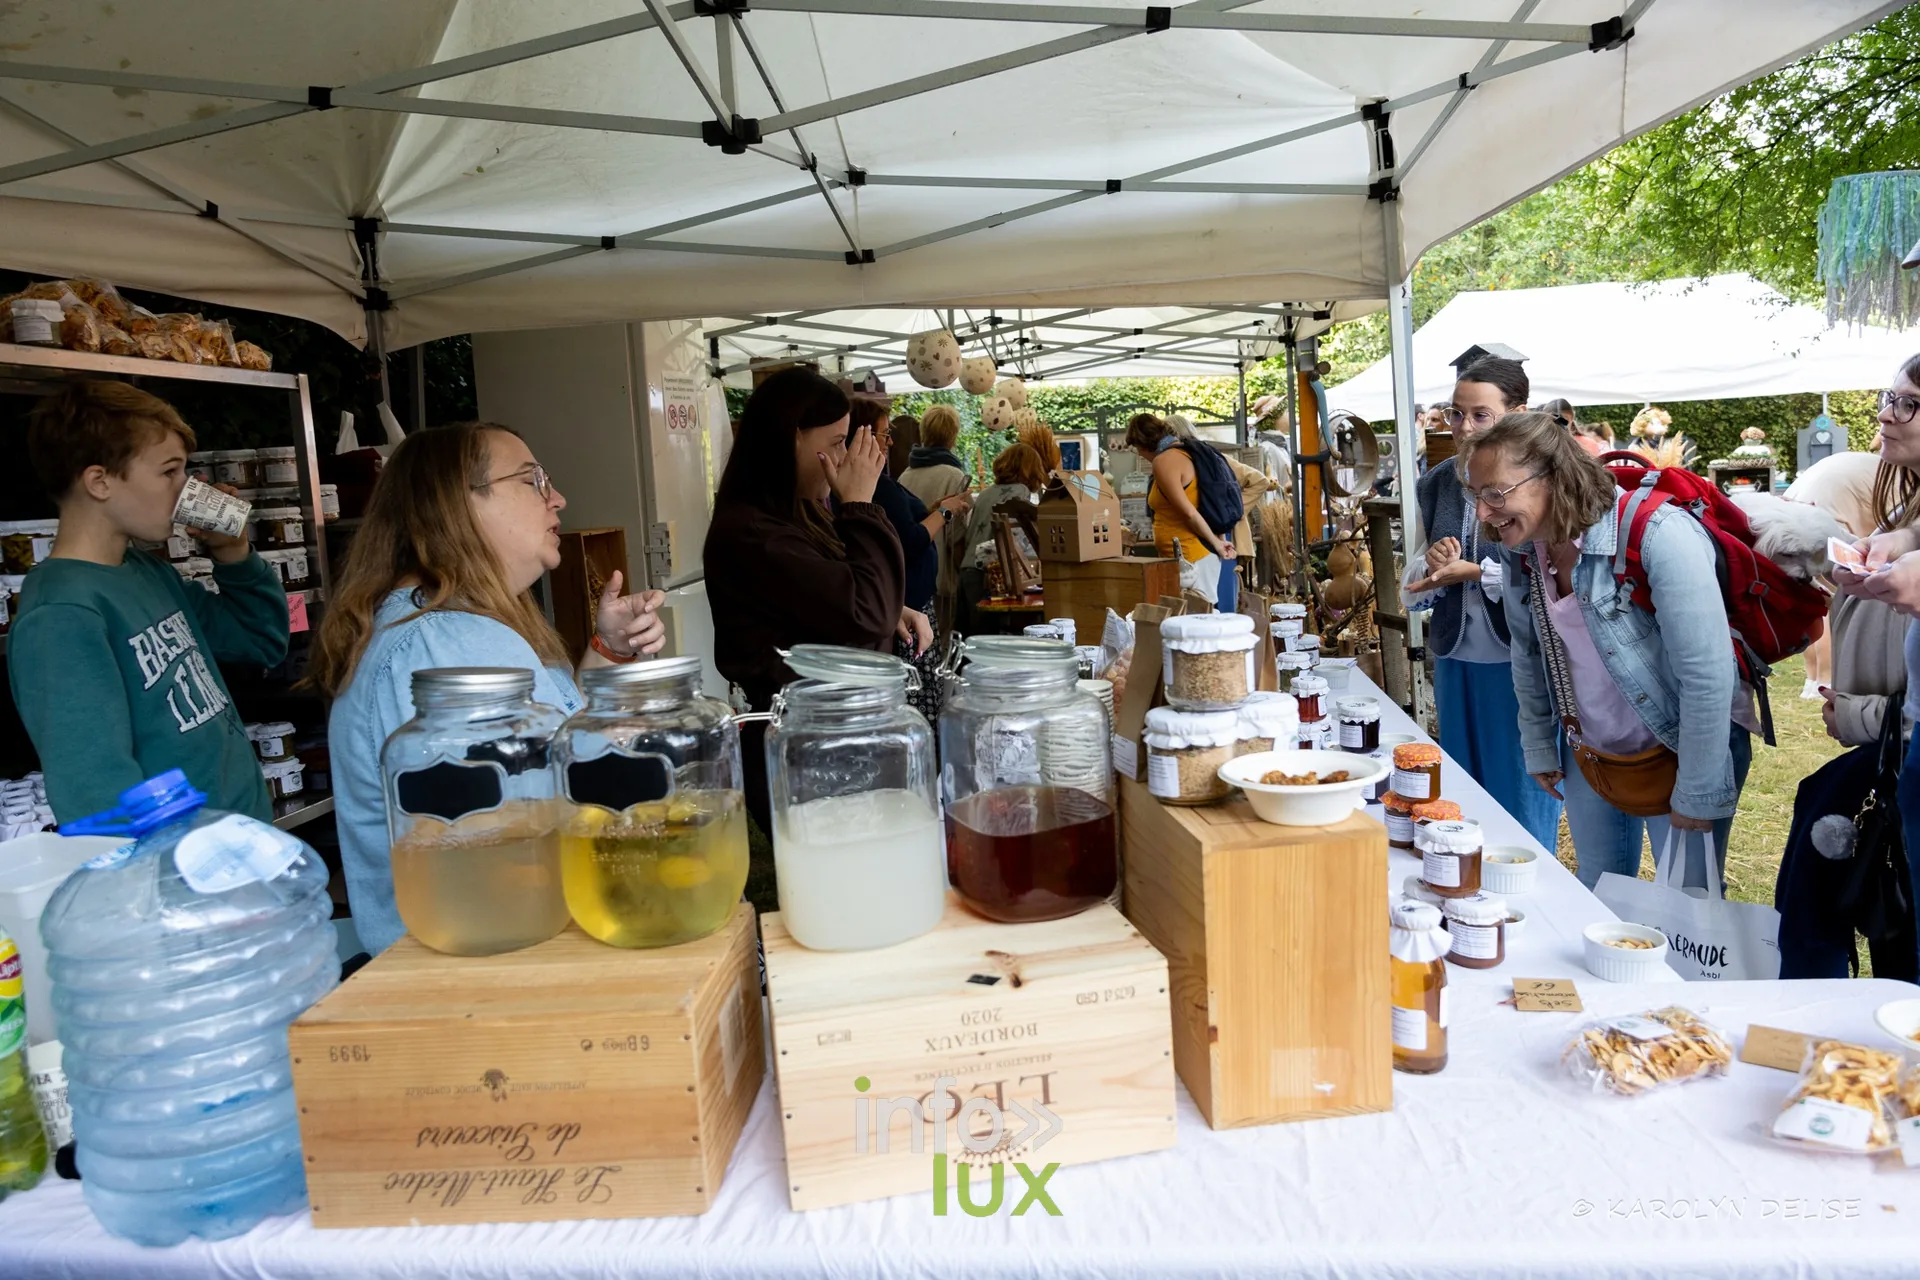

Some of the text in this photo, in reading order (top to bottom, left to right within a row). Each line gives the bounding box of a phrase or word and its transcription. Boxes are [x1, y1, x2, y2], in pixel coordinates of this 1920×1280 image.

[960, 1006, 1003, 1026] 2020
[923, 1022, 1039, 1053] BORDEAUX
[329, 1044, 372, 1063] 1999
[416, 1121, 582, 1162] de Giscours
[573, 1165, 622, 1205] Le
